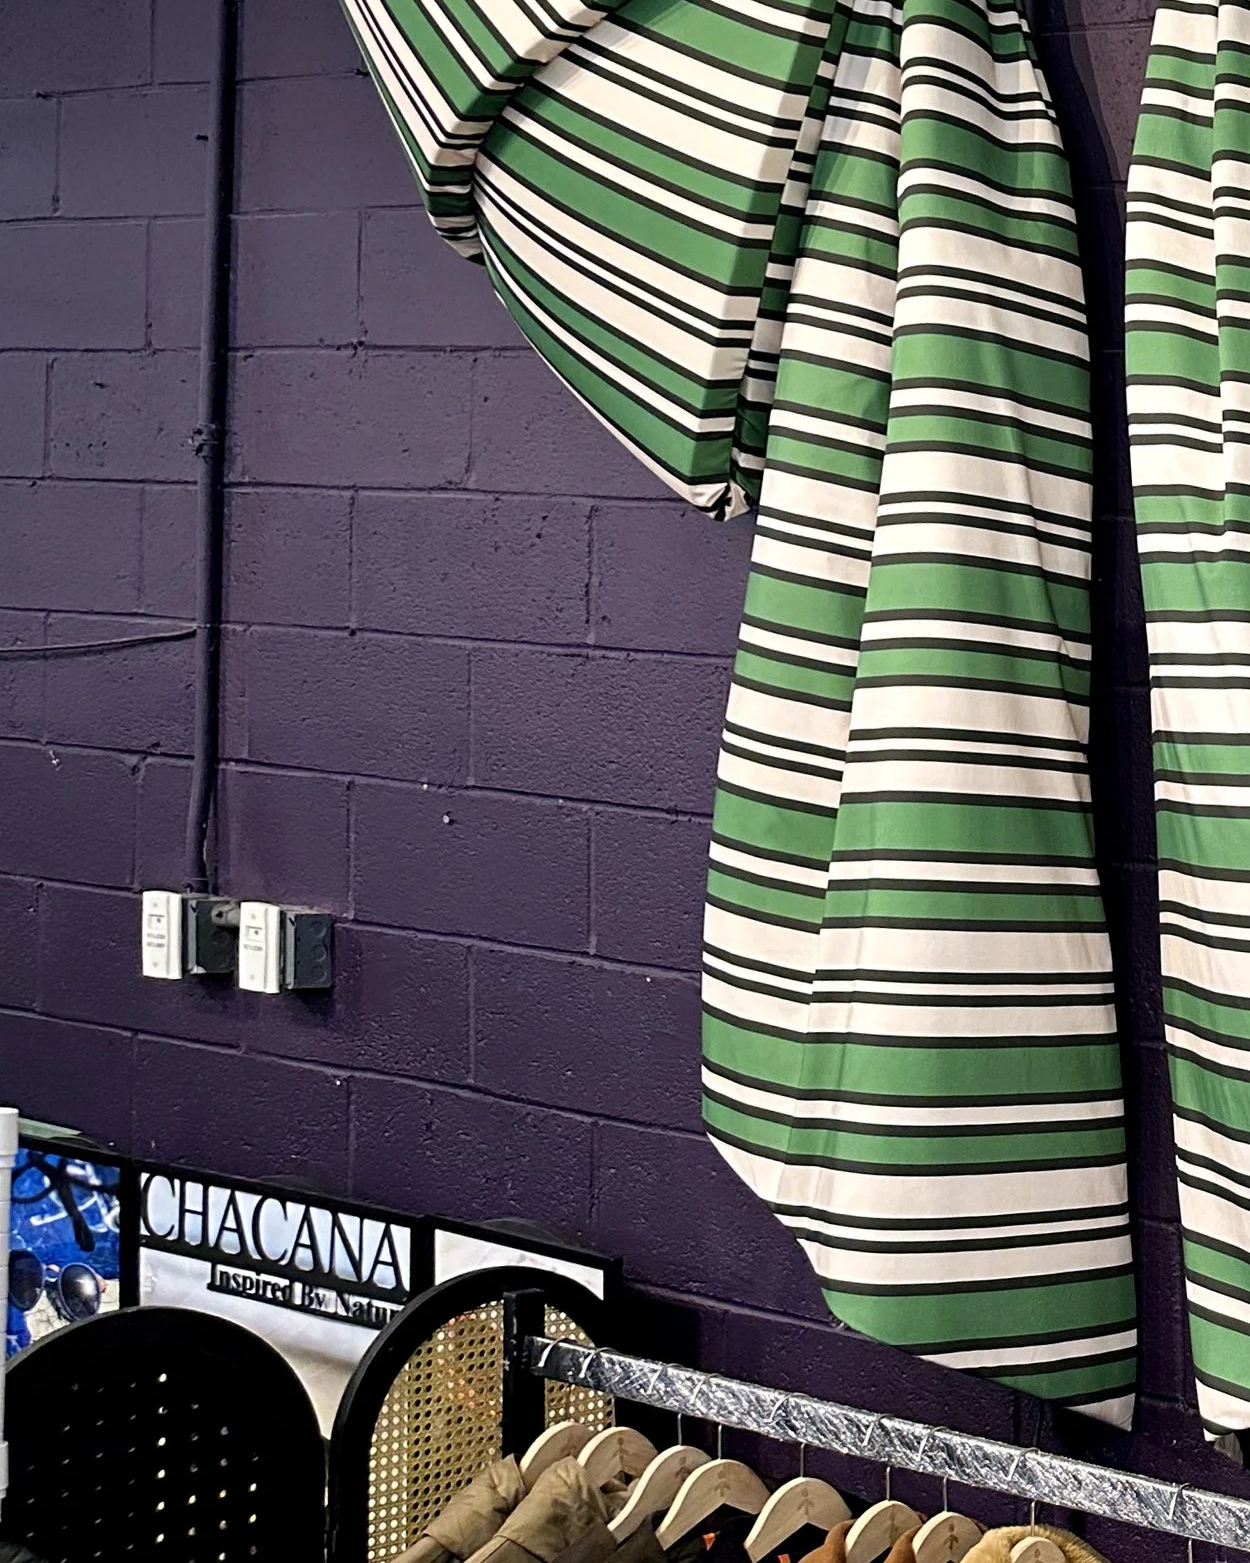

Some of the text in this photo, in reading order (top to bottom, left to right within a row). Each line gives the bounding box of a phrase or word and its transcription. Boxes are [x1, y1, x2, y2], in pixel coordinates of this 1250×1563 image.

[140, 1173, 410, 1292] CHACANA
[208, 1262, 293, 1303] Inspired
[301, 1280, 326, 1311] By
